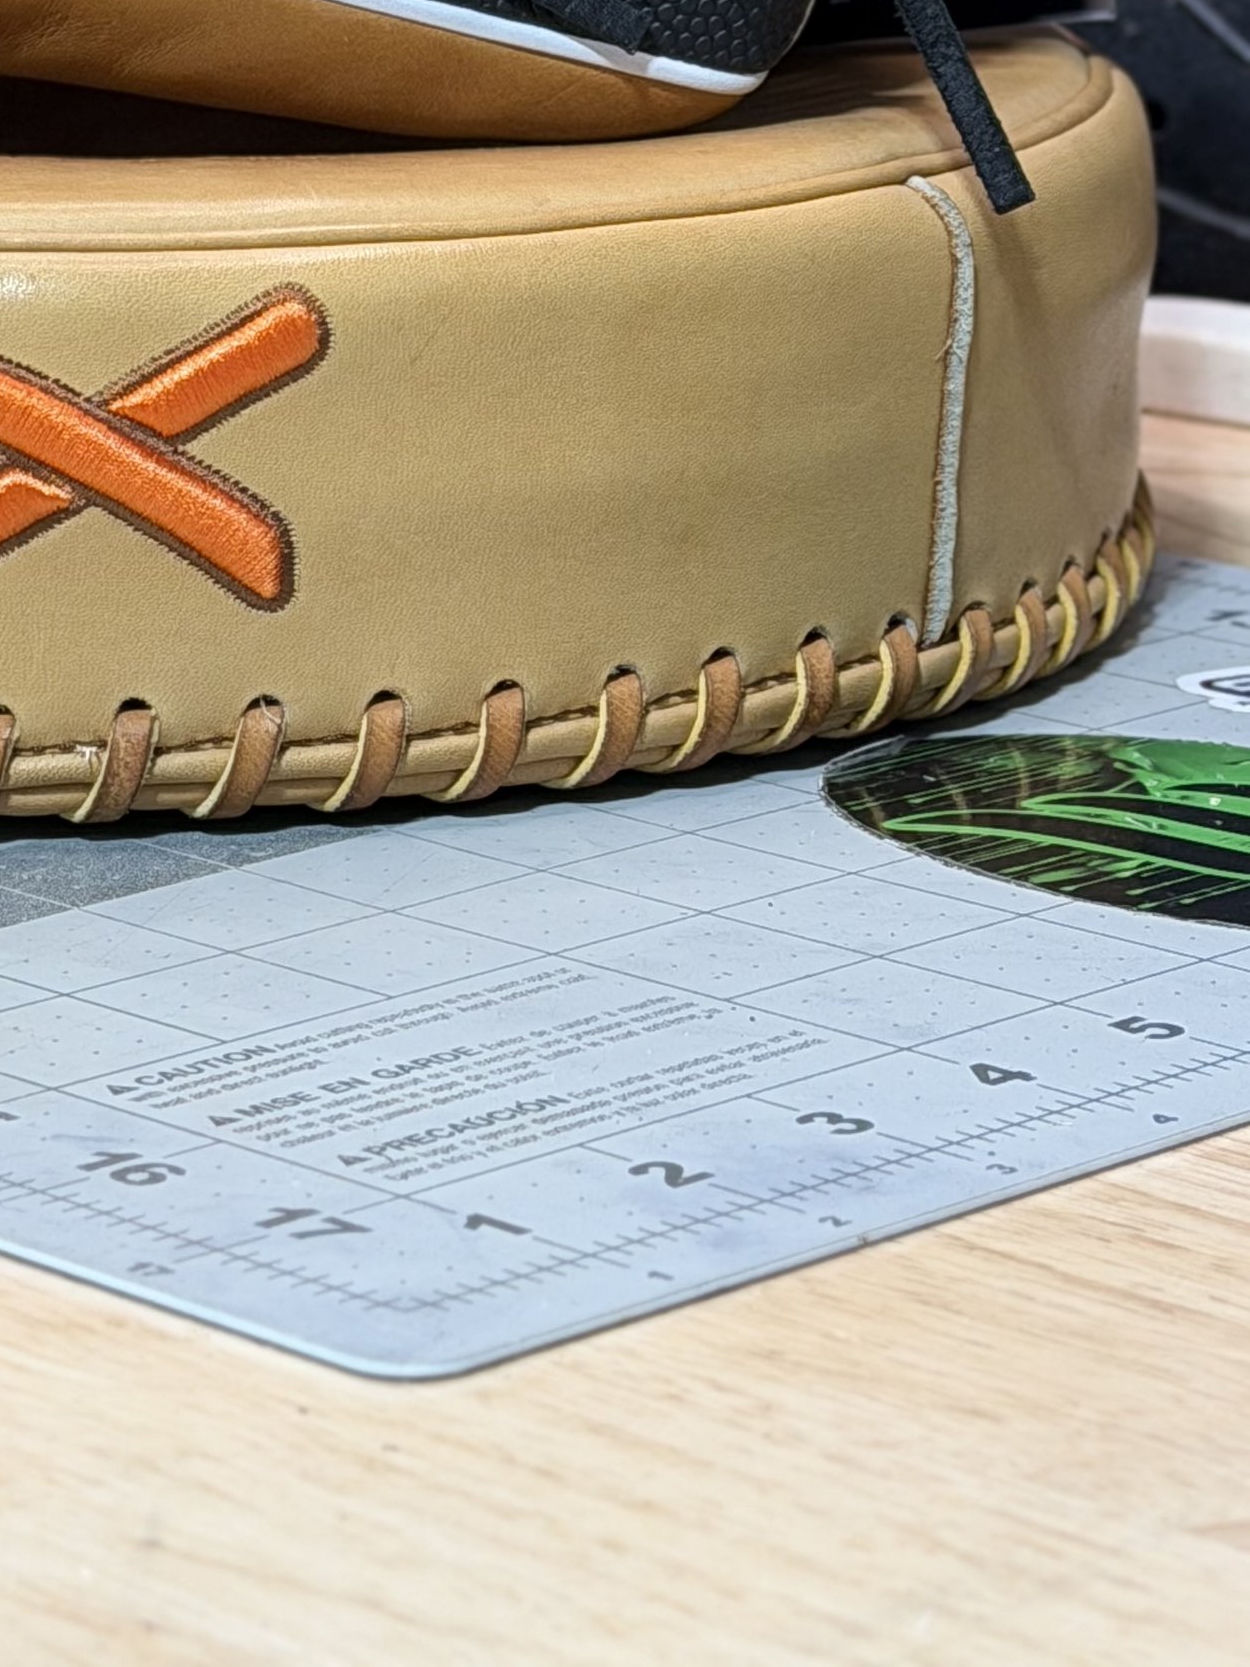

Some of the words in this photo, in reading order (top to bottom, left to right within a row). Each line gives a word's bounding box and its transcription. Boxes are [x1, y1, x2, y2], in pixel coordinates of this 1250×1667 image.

[134, 1044, 278, 1087] CAUTION
[234, 1090, 323, 1117] MISE
[319, 1076, 372, 1094] EN
[370, 1044, 483, 1080] GARDE
[463, 1212, 532, 1236] 1
[627, 1160, 716, 1189] 2
[795, 1111, 875, 1135] 3
[969, 1062, 1038, 1087] 4
[1107, 1015, 1186, 1040] 5
[818, 1215, 853, 1228] 2
[985, 1163, 1019, 1175] 3
[1152, 1113, 1179, 1125] 4
[76, 1150, 187, 1187] 16
[254, 1206, 373, 1240] 17
